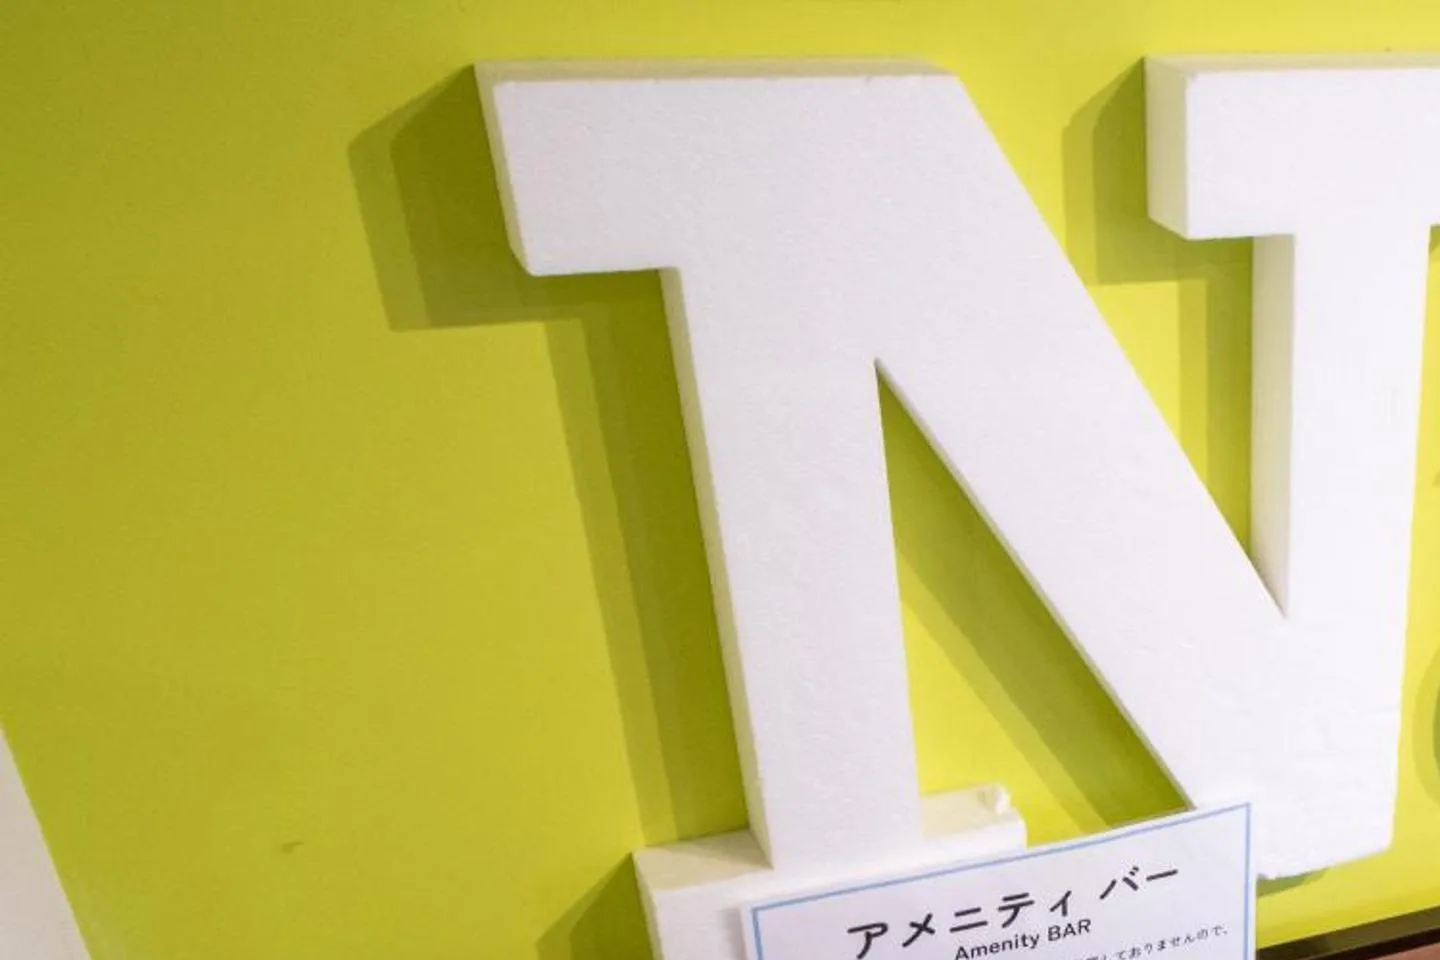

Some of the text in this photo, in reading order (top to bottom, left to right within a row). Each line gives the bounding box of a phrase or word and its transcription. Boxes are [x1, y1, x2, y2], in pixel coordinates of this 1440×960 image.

[847, 866, 1179, 960] アメニティ バー
[1047, 919, 1092, 943] BAR
